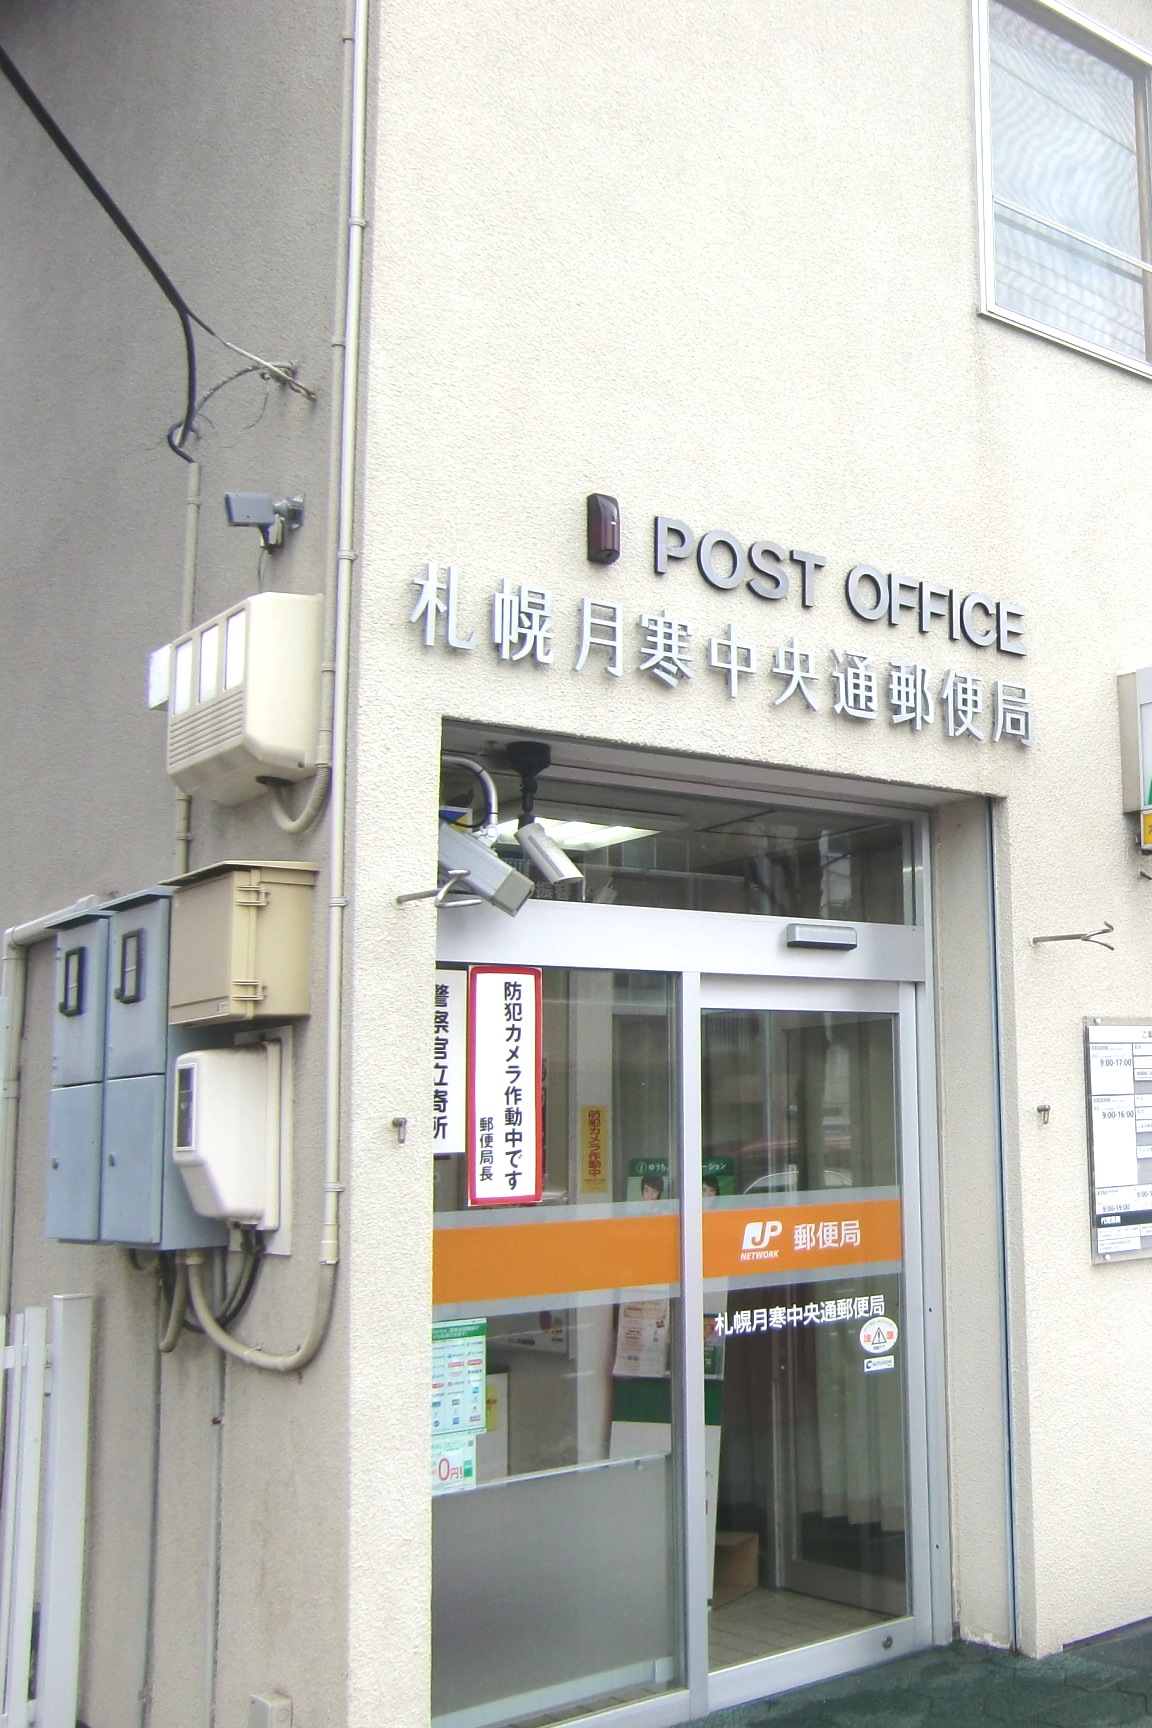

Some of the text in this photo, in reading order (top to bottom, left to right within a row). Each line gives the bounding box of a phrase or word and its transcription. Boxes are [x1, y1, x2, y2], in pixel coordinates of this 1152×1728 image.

[652, 515, 1030, 656] POST OFFICE
[410, 561, 1036, 747] 札幌月寒中央通郵便局
[1100, 1058, 1132, 1067] 9:00-17:00
[504, 981, 523, 1191] 防犯カメラ作動中です
[1102, 1110, 1134, 1119] 9:00-16:00
[479, 1116, 494, 1182] 郵便局長
[588, 1109, 602, 1177] 防犯カメラ作動中
[648, 1162, 671, 1172] ゆうち
[740, 1250, 780, 1261] NETWORK
[742, 1220, 861, 1251] JP 郵便局
[714, 1294, 886, 1337] 札幌月寒中央通郵便局
